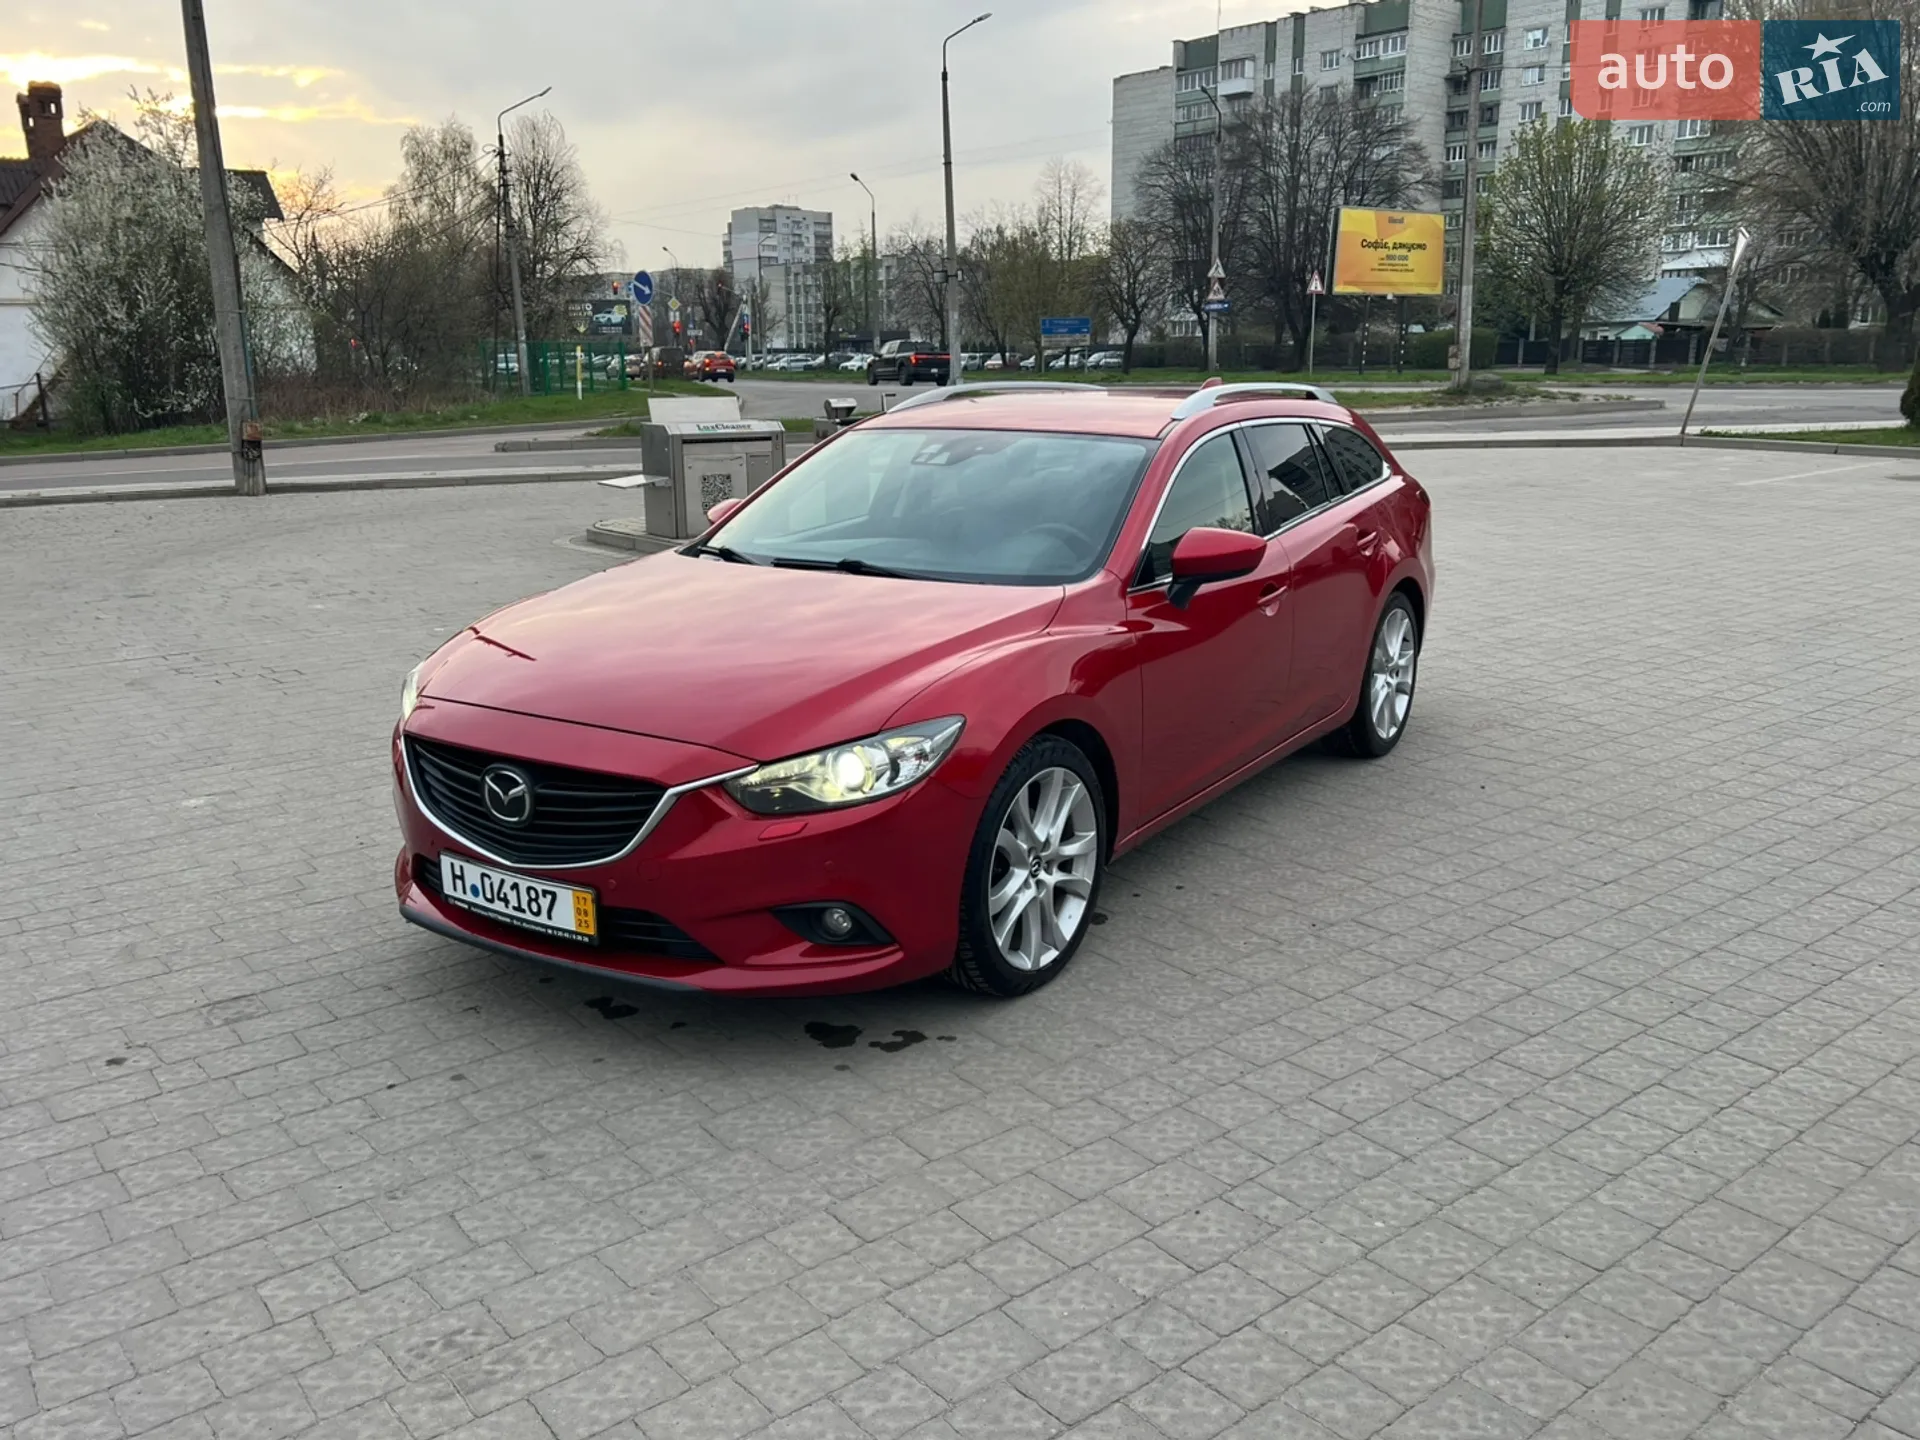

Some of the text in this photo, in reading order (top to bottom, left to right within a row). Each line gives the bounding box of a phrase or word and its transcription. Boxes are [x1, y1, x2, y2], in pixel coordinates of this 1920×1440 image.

[696, 423, 752, 431] LuxCleaner
[450, 861, 468, 895] H
[480, 871, 558, 921] 04187
[576, 895, 588, 906] 17
[576, 907, 589, 917] 08
[577, 918, 590, 928] 25
